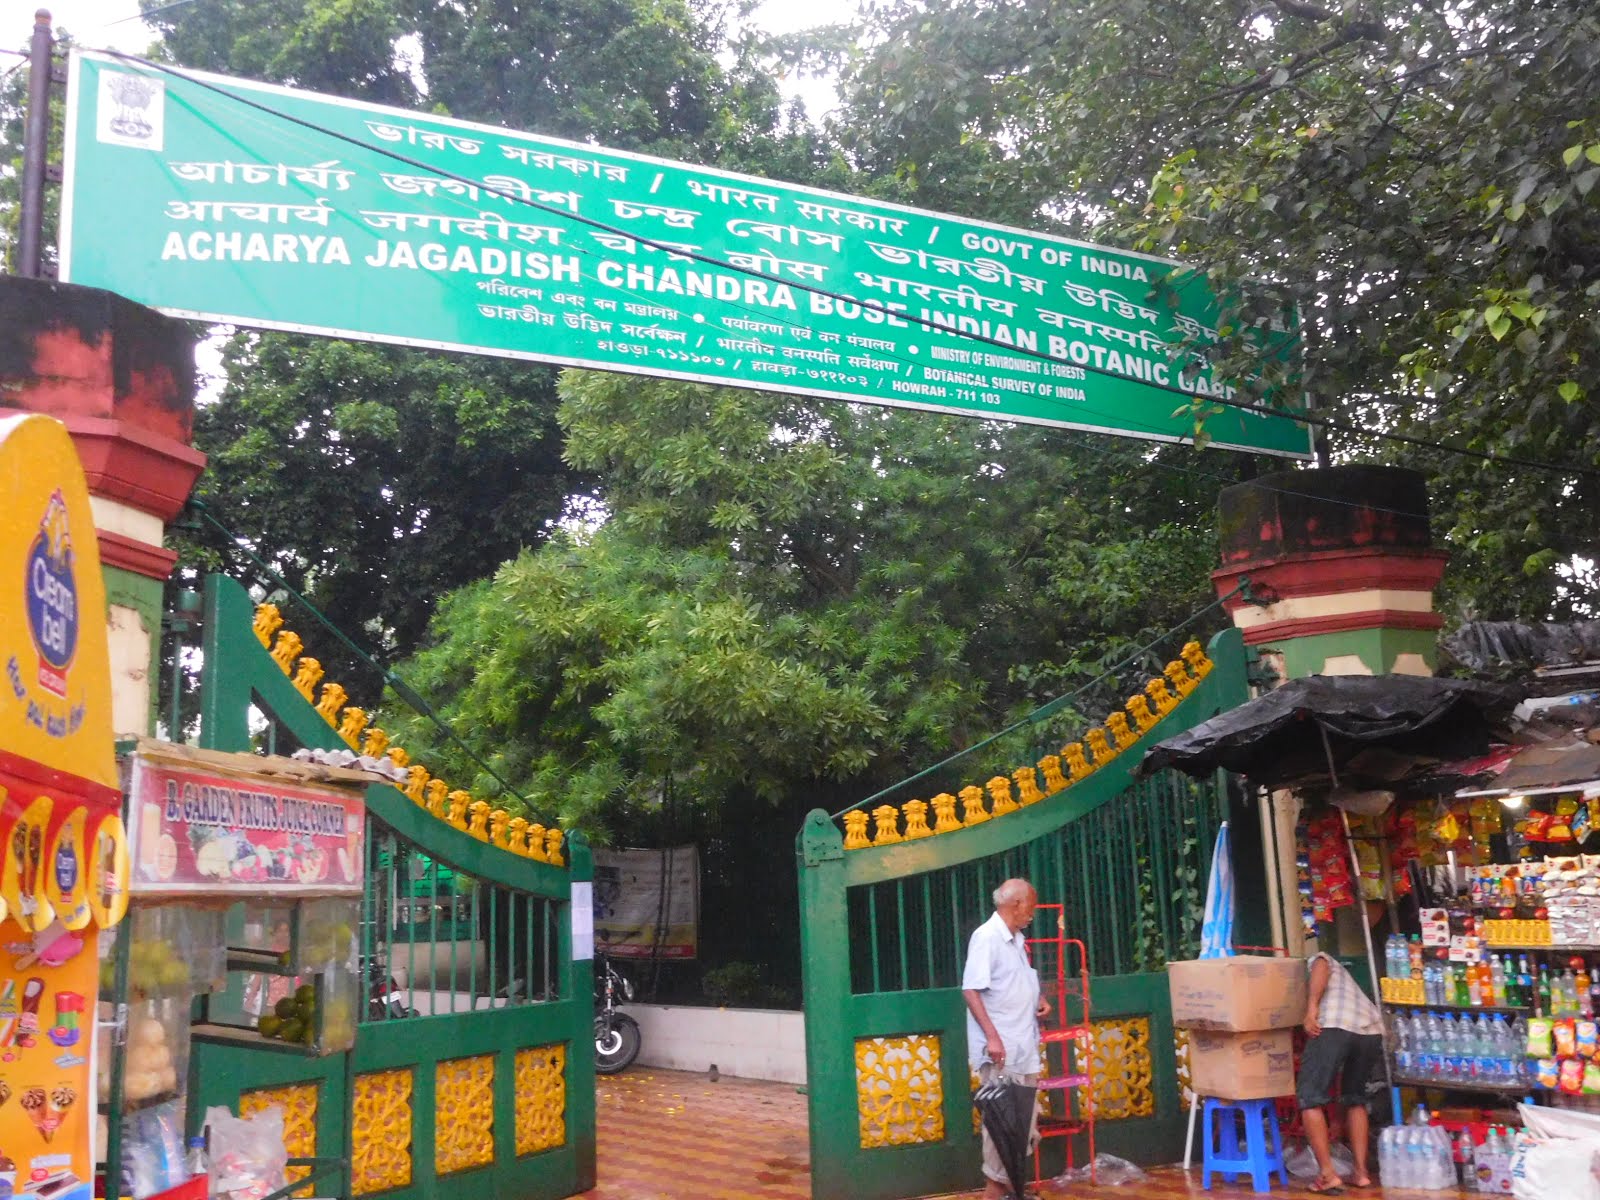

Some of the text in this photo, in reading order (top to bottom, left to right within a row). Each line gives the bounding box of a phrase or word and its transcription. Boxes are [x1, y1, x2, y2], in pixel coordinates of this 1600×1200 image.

[364, 120, 485, 154] ভারত
[498, 144, 630, 183] সরকার
[380, 174, 583, 213] জগদীশ
[609, 198, 702, 229] চন্দ্র
[726, 219, 845, 252] বোস
[687, 180, 780, 213] भारत
[795, 200, 908, 236] सरकार
[164, 198, 335, 226] आचार्य
[359, 211, 566, 246] जगदीश
[724, 249, 829, 282] बोस
[855, 272, 1019, 318] भारतीय
[961, 232, 1148, 283] GOVT OF INDIA
[161, 231, 351, 265] ACHARYA
[365, 240, 580, 283] JAGADISH
[597, 261, 797, 311] CHANDRA
[810, 291, 908, 329] BOSE
[921, 308, 1037, 352] INDIAN
[1048, 335, 1169, 386] BOTANIC
[476, 278, 542, 300] পরিবেশ
[551, 292, 585, 308] এবং
[594, 298, 617, 312] বন
[476, 303, 556, 327] ভারতীয়
[716, 337, 776, 357] भारतीय
[781, 347, 841, 365] वनस्पति
[846, 353, 900, 373] सर्वेक्षण
[720, 315, 896, 352] पर्यावरण एवं वन मंत्रालय
[924, 367, 1086, 401] BOTANICAL SURVEY OF INDIA
[931, 345, 1086, 381] MINISTRY OF ENVIRONMENT & FORESTS
[892, 380, 947, 398] HOWRAH
[956, 389, 977, 401] 711
[980, 392, 1000, 405] 103
[33, 556, 74, 621] Cream
[42, 604, 66, 655] bell
[183, 782, 236, 826] GARDEN
